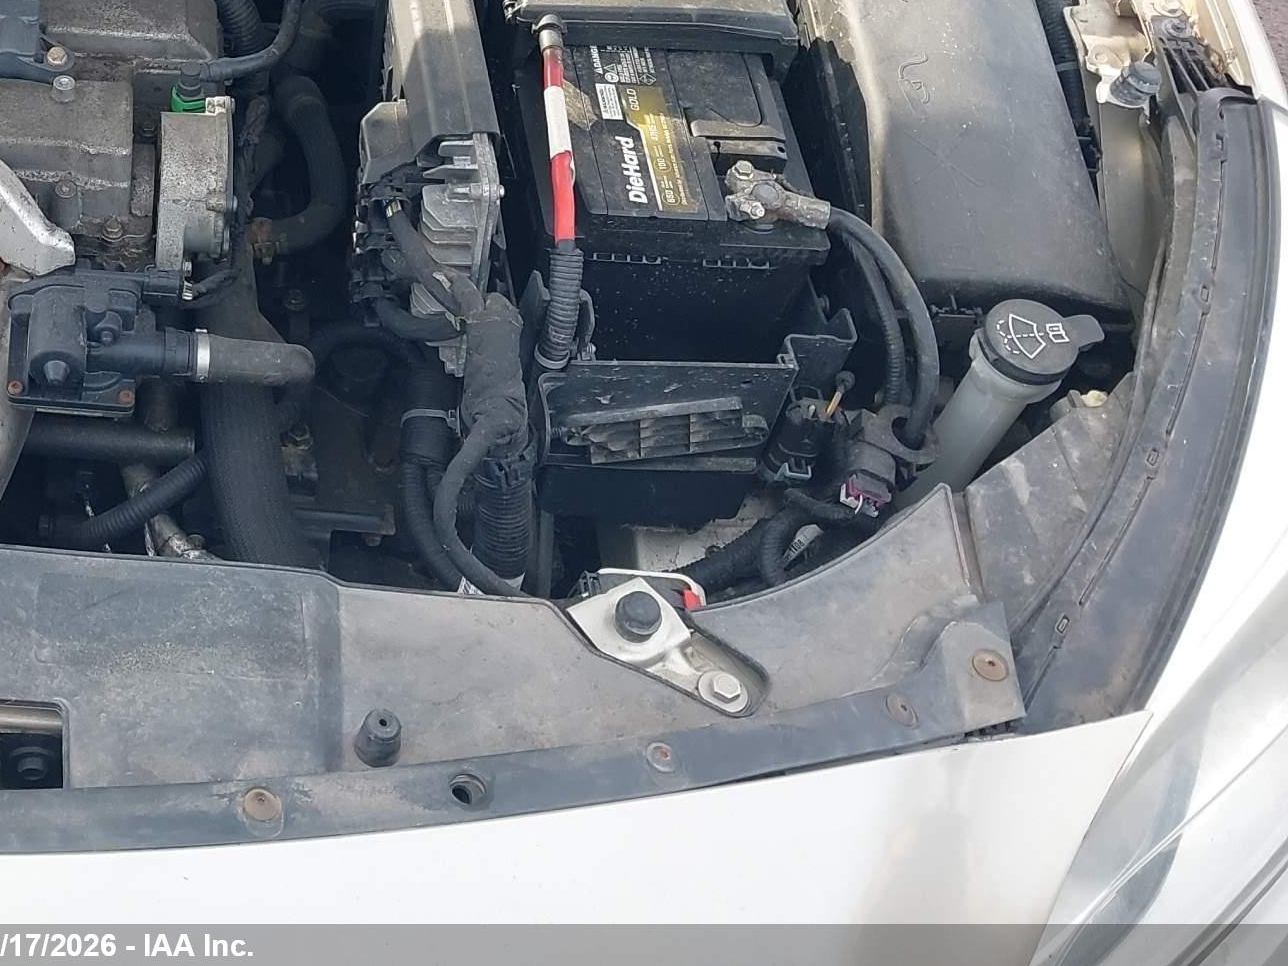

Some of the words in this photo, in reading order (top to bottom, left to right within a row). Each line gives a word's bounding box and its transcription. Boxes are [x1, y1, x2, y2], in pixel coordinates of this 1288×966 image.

[589, 45, 602, 68] DANGE
[627, 89, 640, 111] GOLD
[615, 136, 648, 203] DieHard
